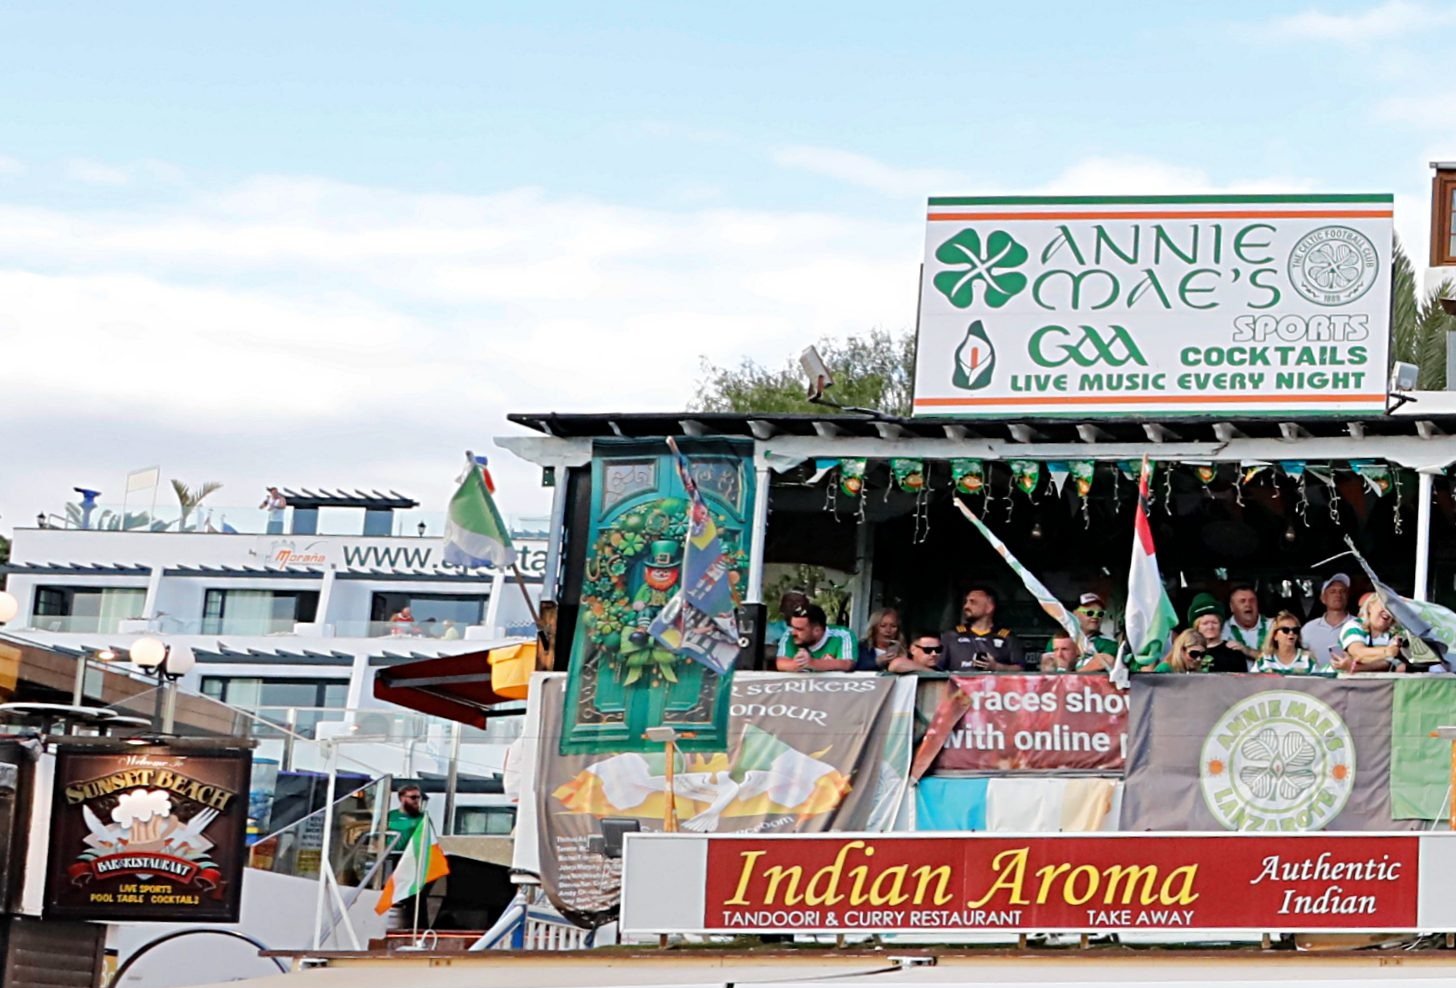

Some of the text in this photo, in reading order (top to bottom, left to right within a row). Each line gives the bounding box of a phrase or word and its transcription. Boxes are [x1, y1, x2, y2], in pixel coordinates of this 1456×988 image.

[1041, 223, 1278, 265] ANNIE
[1292, 230, 1375, 268] THE CELTIC FOOTBALL CLUB
[1032, 266, 1281, 310] MAE'S
[1232, 314, 1370, 342] SPORTS
[1027, 324, 1149, 368] GAA
[1180, 345, 1368, 367] COCKTAILS
[1010, 371, 1366, 392] LIVE MUSIC EVERY NIGHT
[971, 690, 1057, 713] races
[1014, 724, 1111, 752] online
[1216, 699, 1282, 751] ANNIE
[65, 768, 233, 810] SUNSET BEACH
[723, 840, 1199, 907] Indian Aroma
[1250, 855, 1401, 885] Authentic
[90, 893, 199, 905] POOL TABLE COCKTAILS
[119, 884, 172, 894] LIVE SPORTS
[1276, 889, 1378, 916] Indian
[722, 910, 1021, 926] TANDOORI & CURRY RESTAURANT
[1087, 909, 1195, 926] TAKE AWAY
